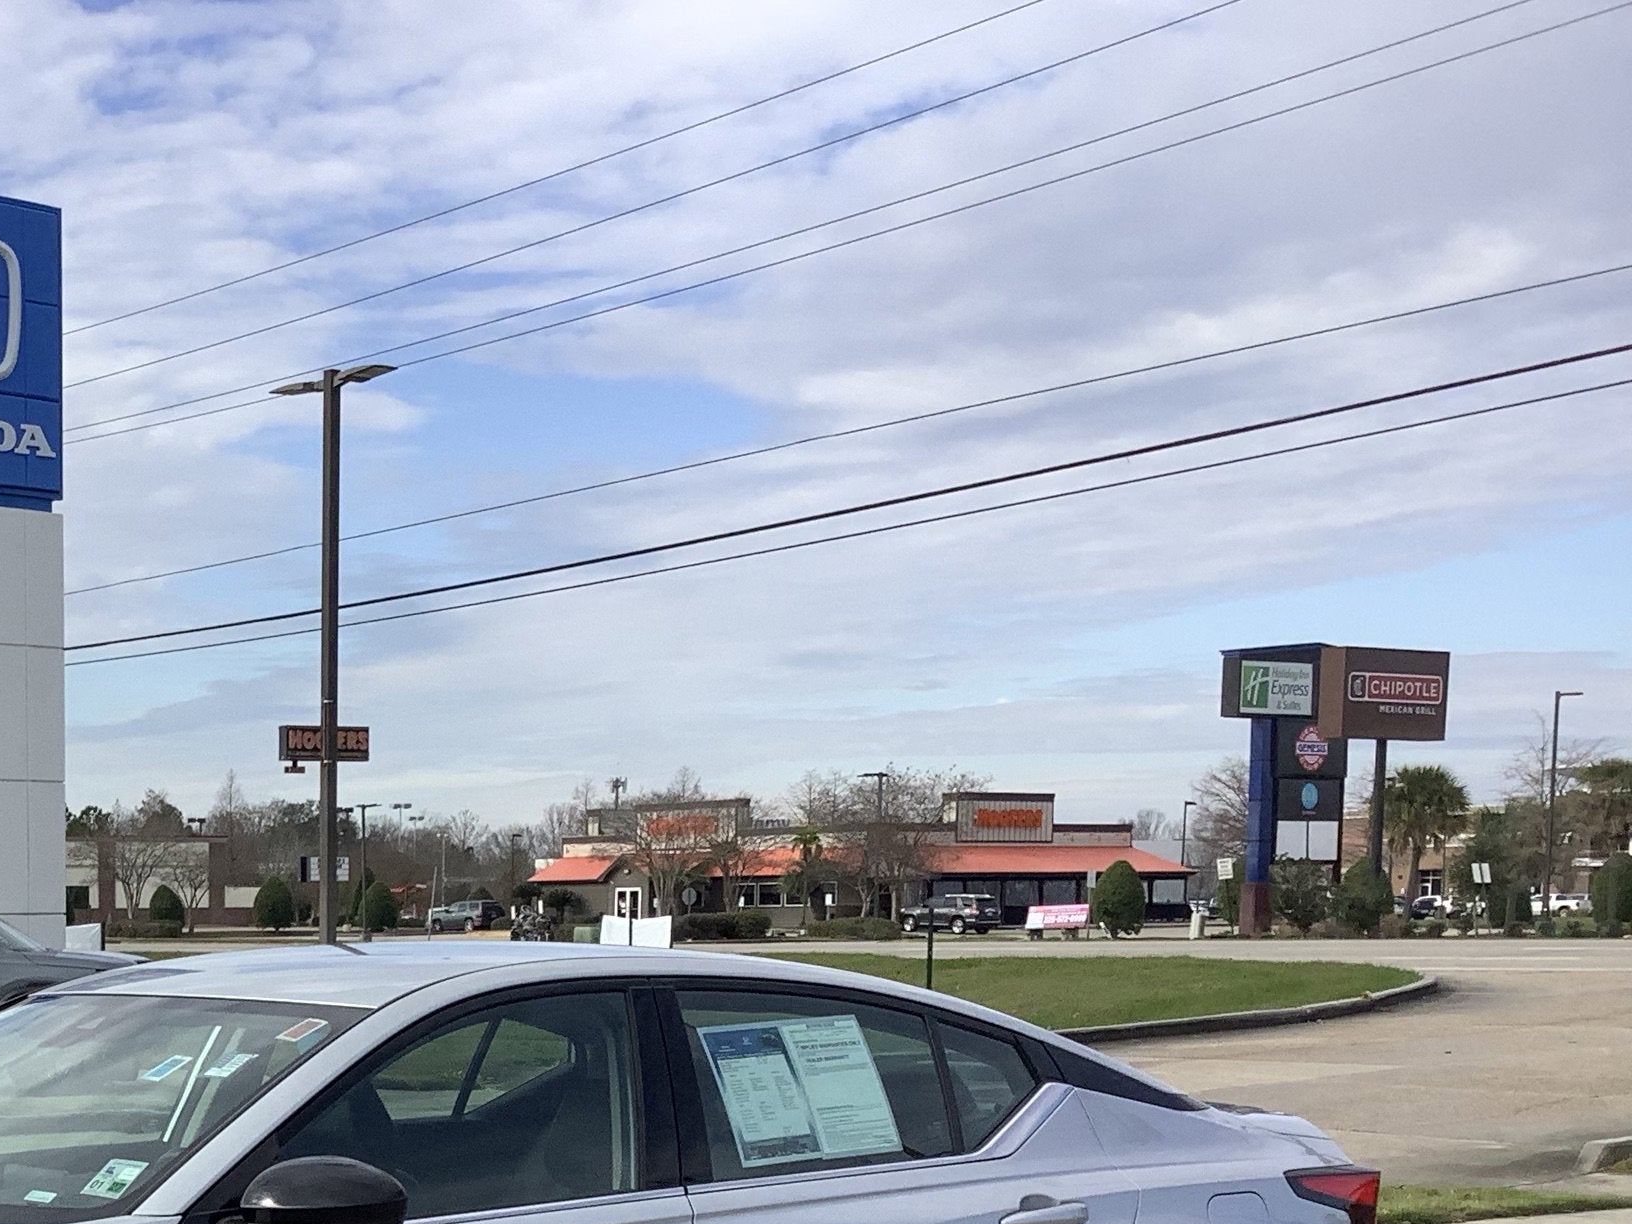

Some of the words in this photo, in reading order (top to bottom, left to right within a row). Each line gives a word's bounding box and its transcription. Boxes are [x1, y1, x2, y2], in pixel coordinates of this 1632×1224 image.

[1271, 679, 1310, 698] Express
[1370, 680, 1439, 697] CHIPOTLE
[1378, 704, 1413, 715] MEXICAN
[89, 1180, 105, 1189] 01
